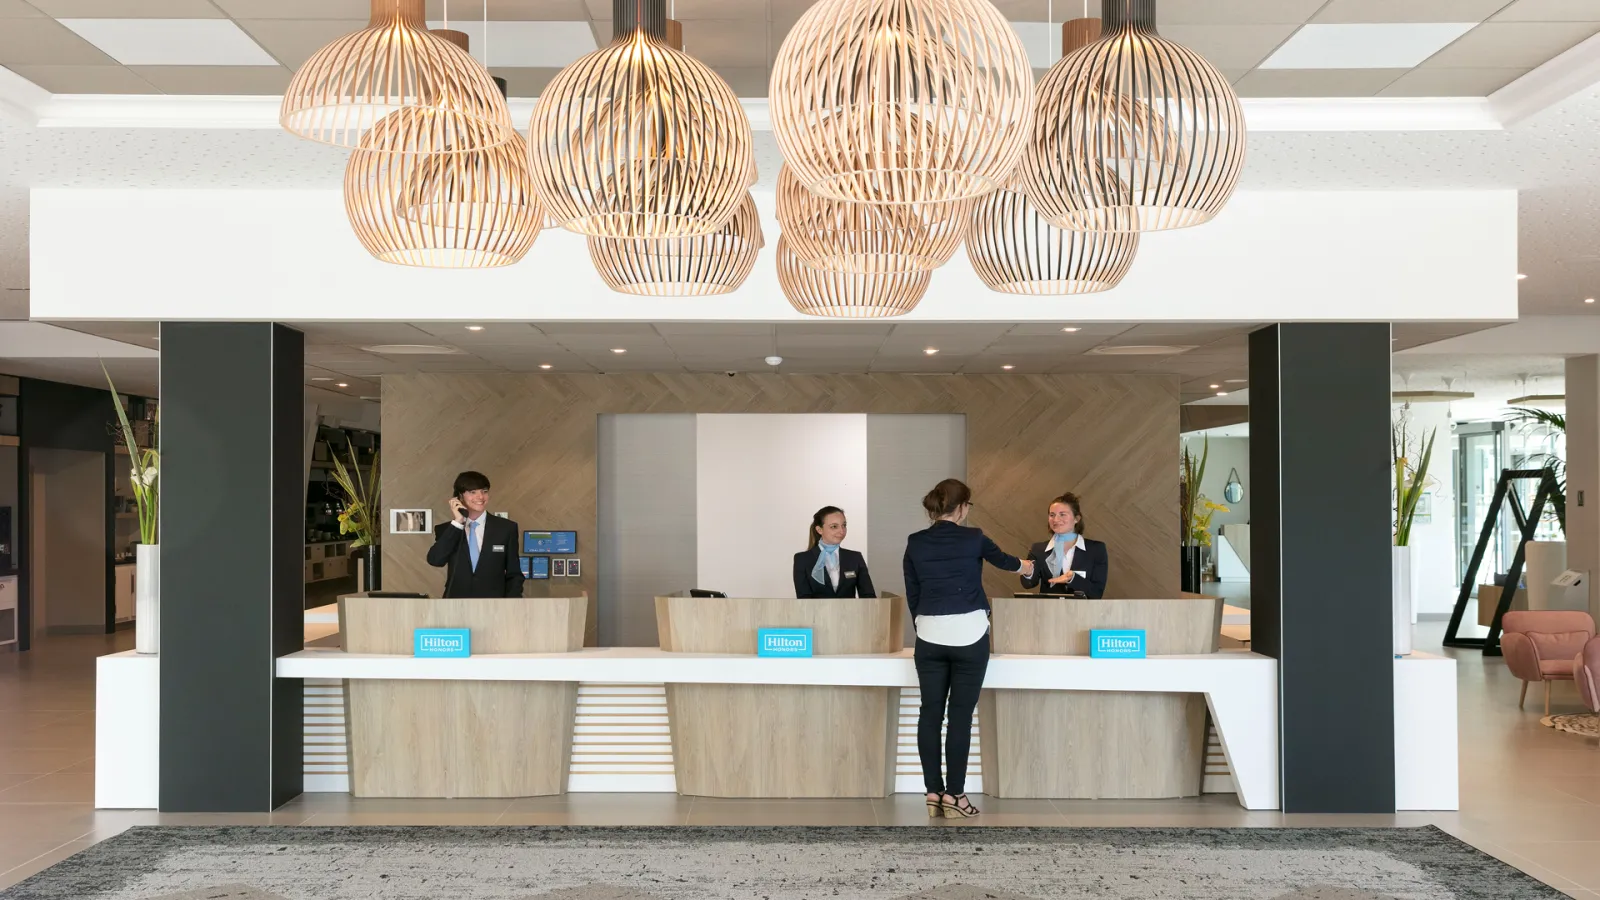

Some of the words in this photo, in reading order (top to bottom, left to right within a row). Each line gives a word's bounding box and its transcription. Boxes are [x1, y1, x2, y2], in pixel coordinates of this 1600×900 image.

[423, 637, 460, 647] Hilton
[767, 637, 804, 647] Hilton
[1101, 638, 1137, 648] Hilton
